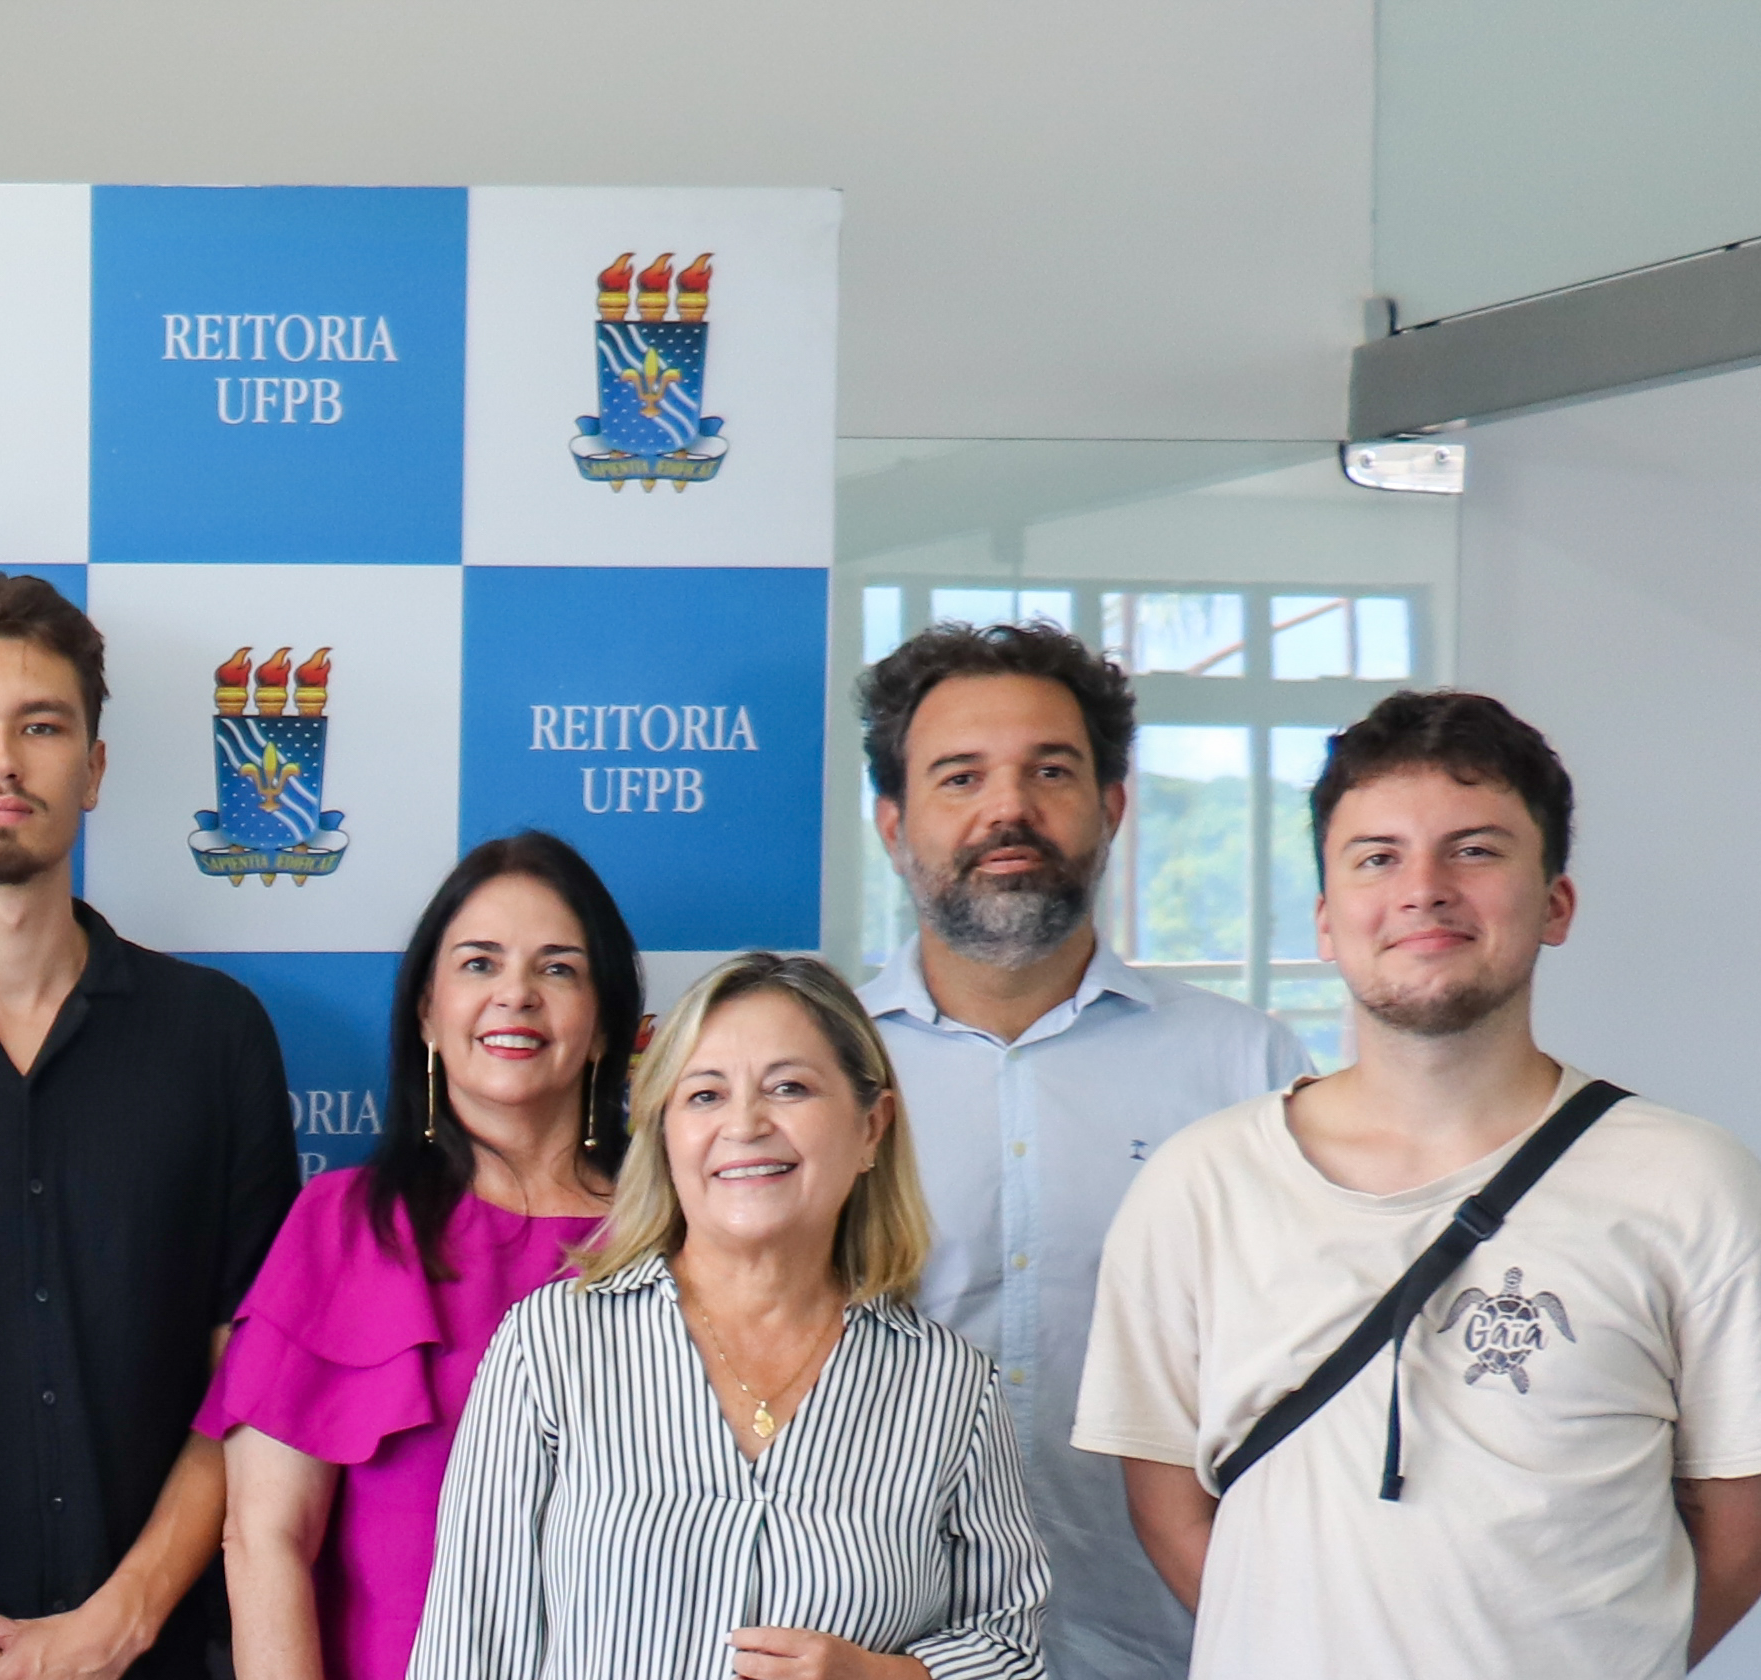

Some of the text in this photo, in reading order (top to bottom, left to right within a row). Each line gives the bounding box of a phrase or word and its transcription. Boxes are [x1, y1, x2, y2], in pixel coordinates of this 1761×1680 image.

[162, 314, 398, 361] REITORIA
[216, 378, 342, 424] UFPB
[530, 705, 758, 751] REITORIA
[581, 768, 704, 813] UFPB
